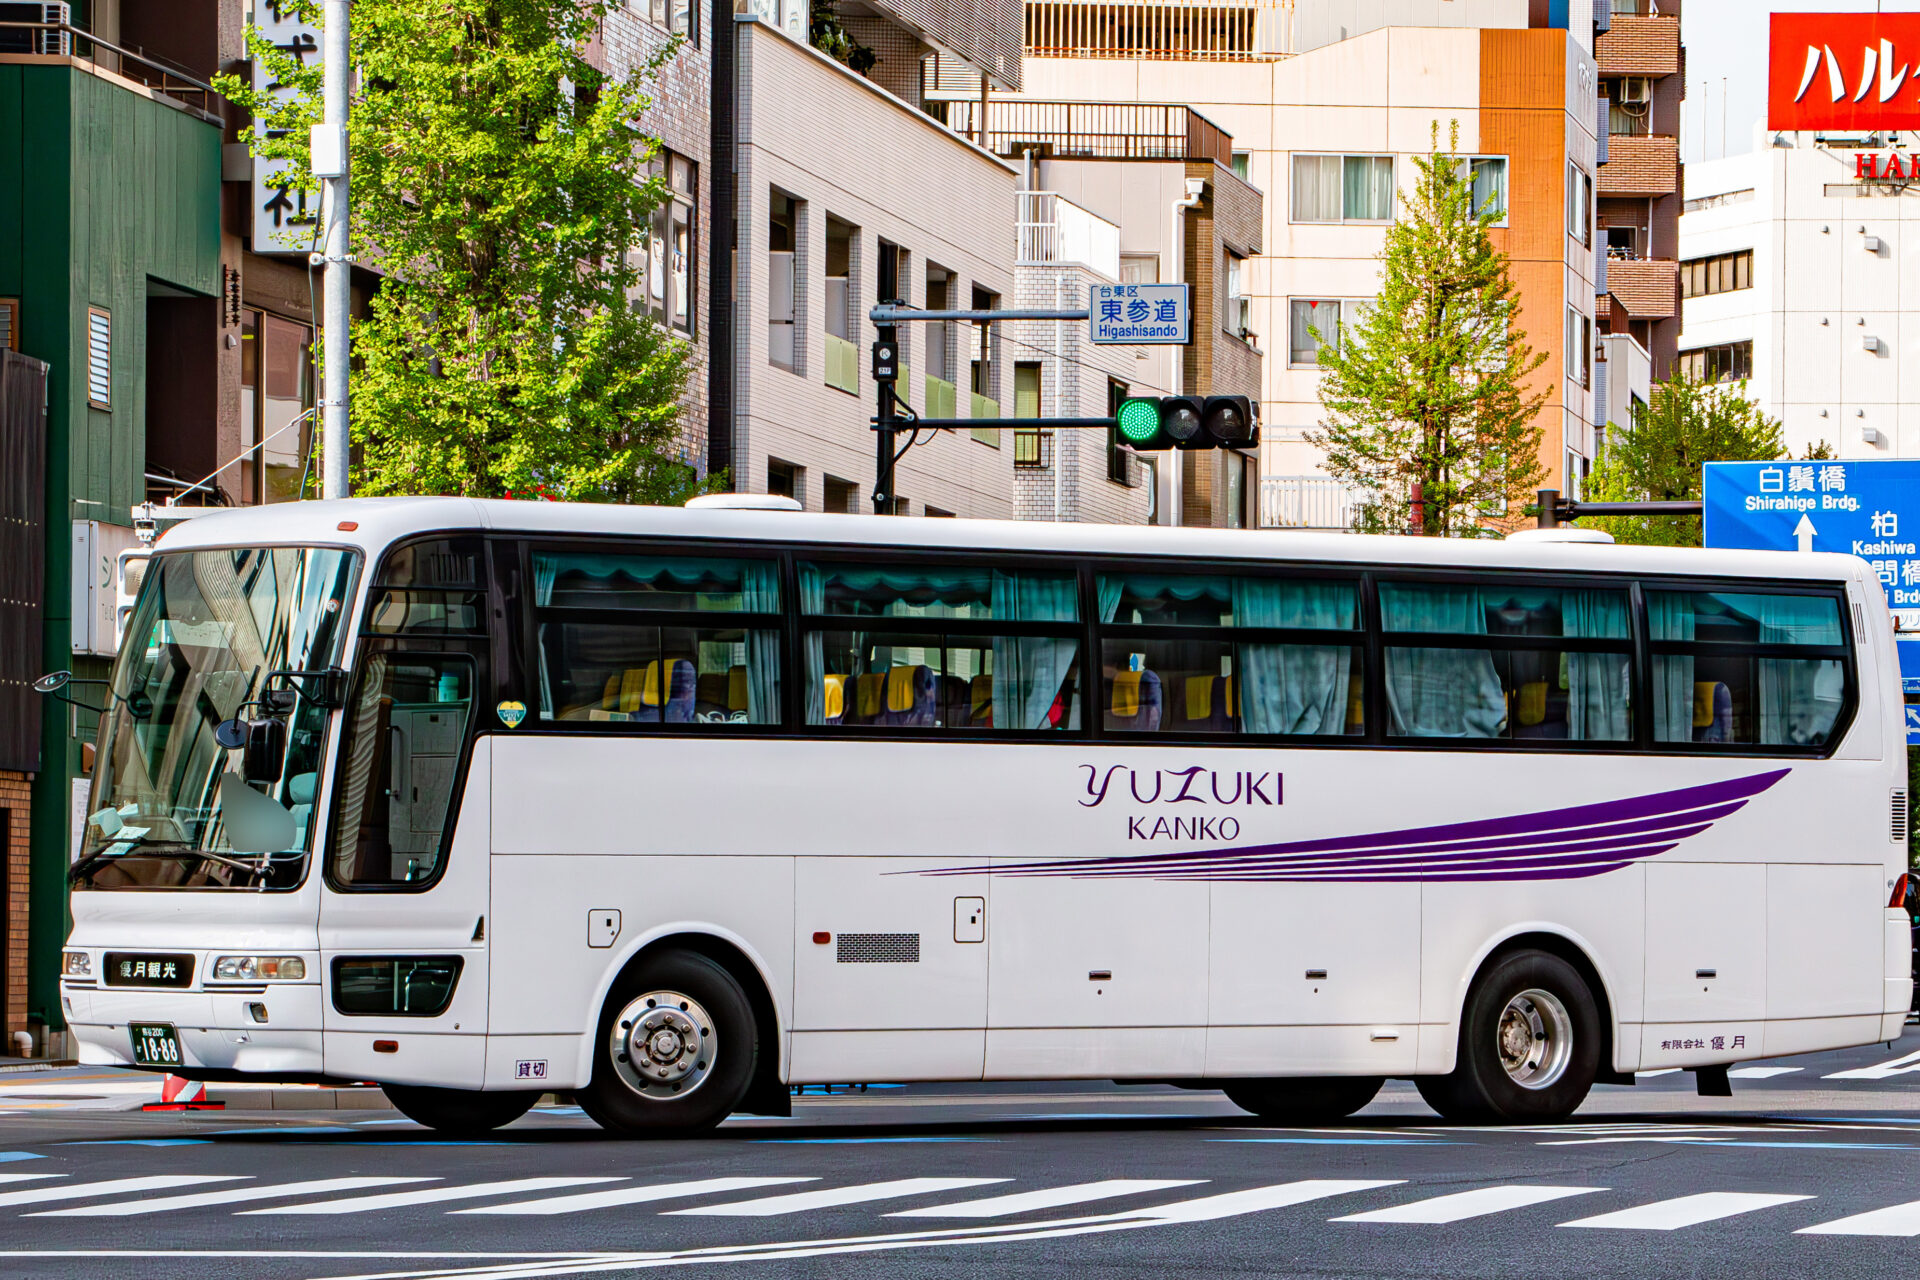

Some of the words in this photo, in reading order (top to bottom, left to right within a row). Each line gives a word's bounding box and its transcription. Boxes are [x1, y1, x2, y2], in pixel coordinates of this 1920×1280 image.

[1794, 37, 1920, 104] ハル
[1100, 285, 1139, 298] 台東区
[1099, 298, 1178, 323] 東参道
[1099, 324, 1178, 339] Higashisando
[1745, 495, 1817, 511] Shirahige
[1822, 495, 1861, 511] Brdg.
[1871, 510, 1898, 537] 柏
[1852, 540, 1916, 555] Kashiwa
[1894, 590, 1920, 604] Brd
[1078, 764, 1284, 807] YUZUKI
[1128, 816, 1240, 840] KANKO
[120, 961, 176, 979] 優月観光
[1661, 1039, 1705, 1050] 有限会社
[518, 1062, 545, 1077] 貸切
